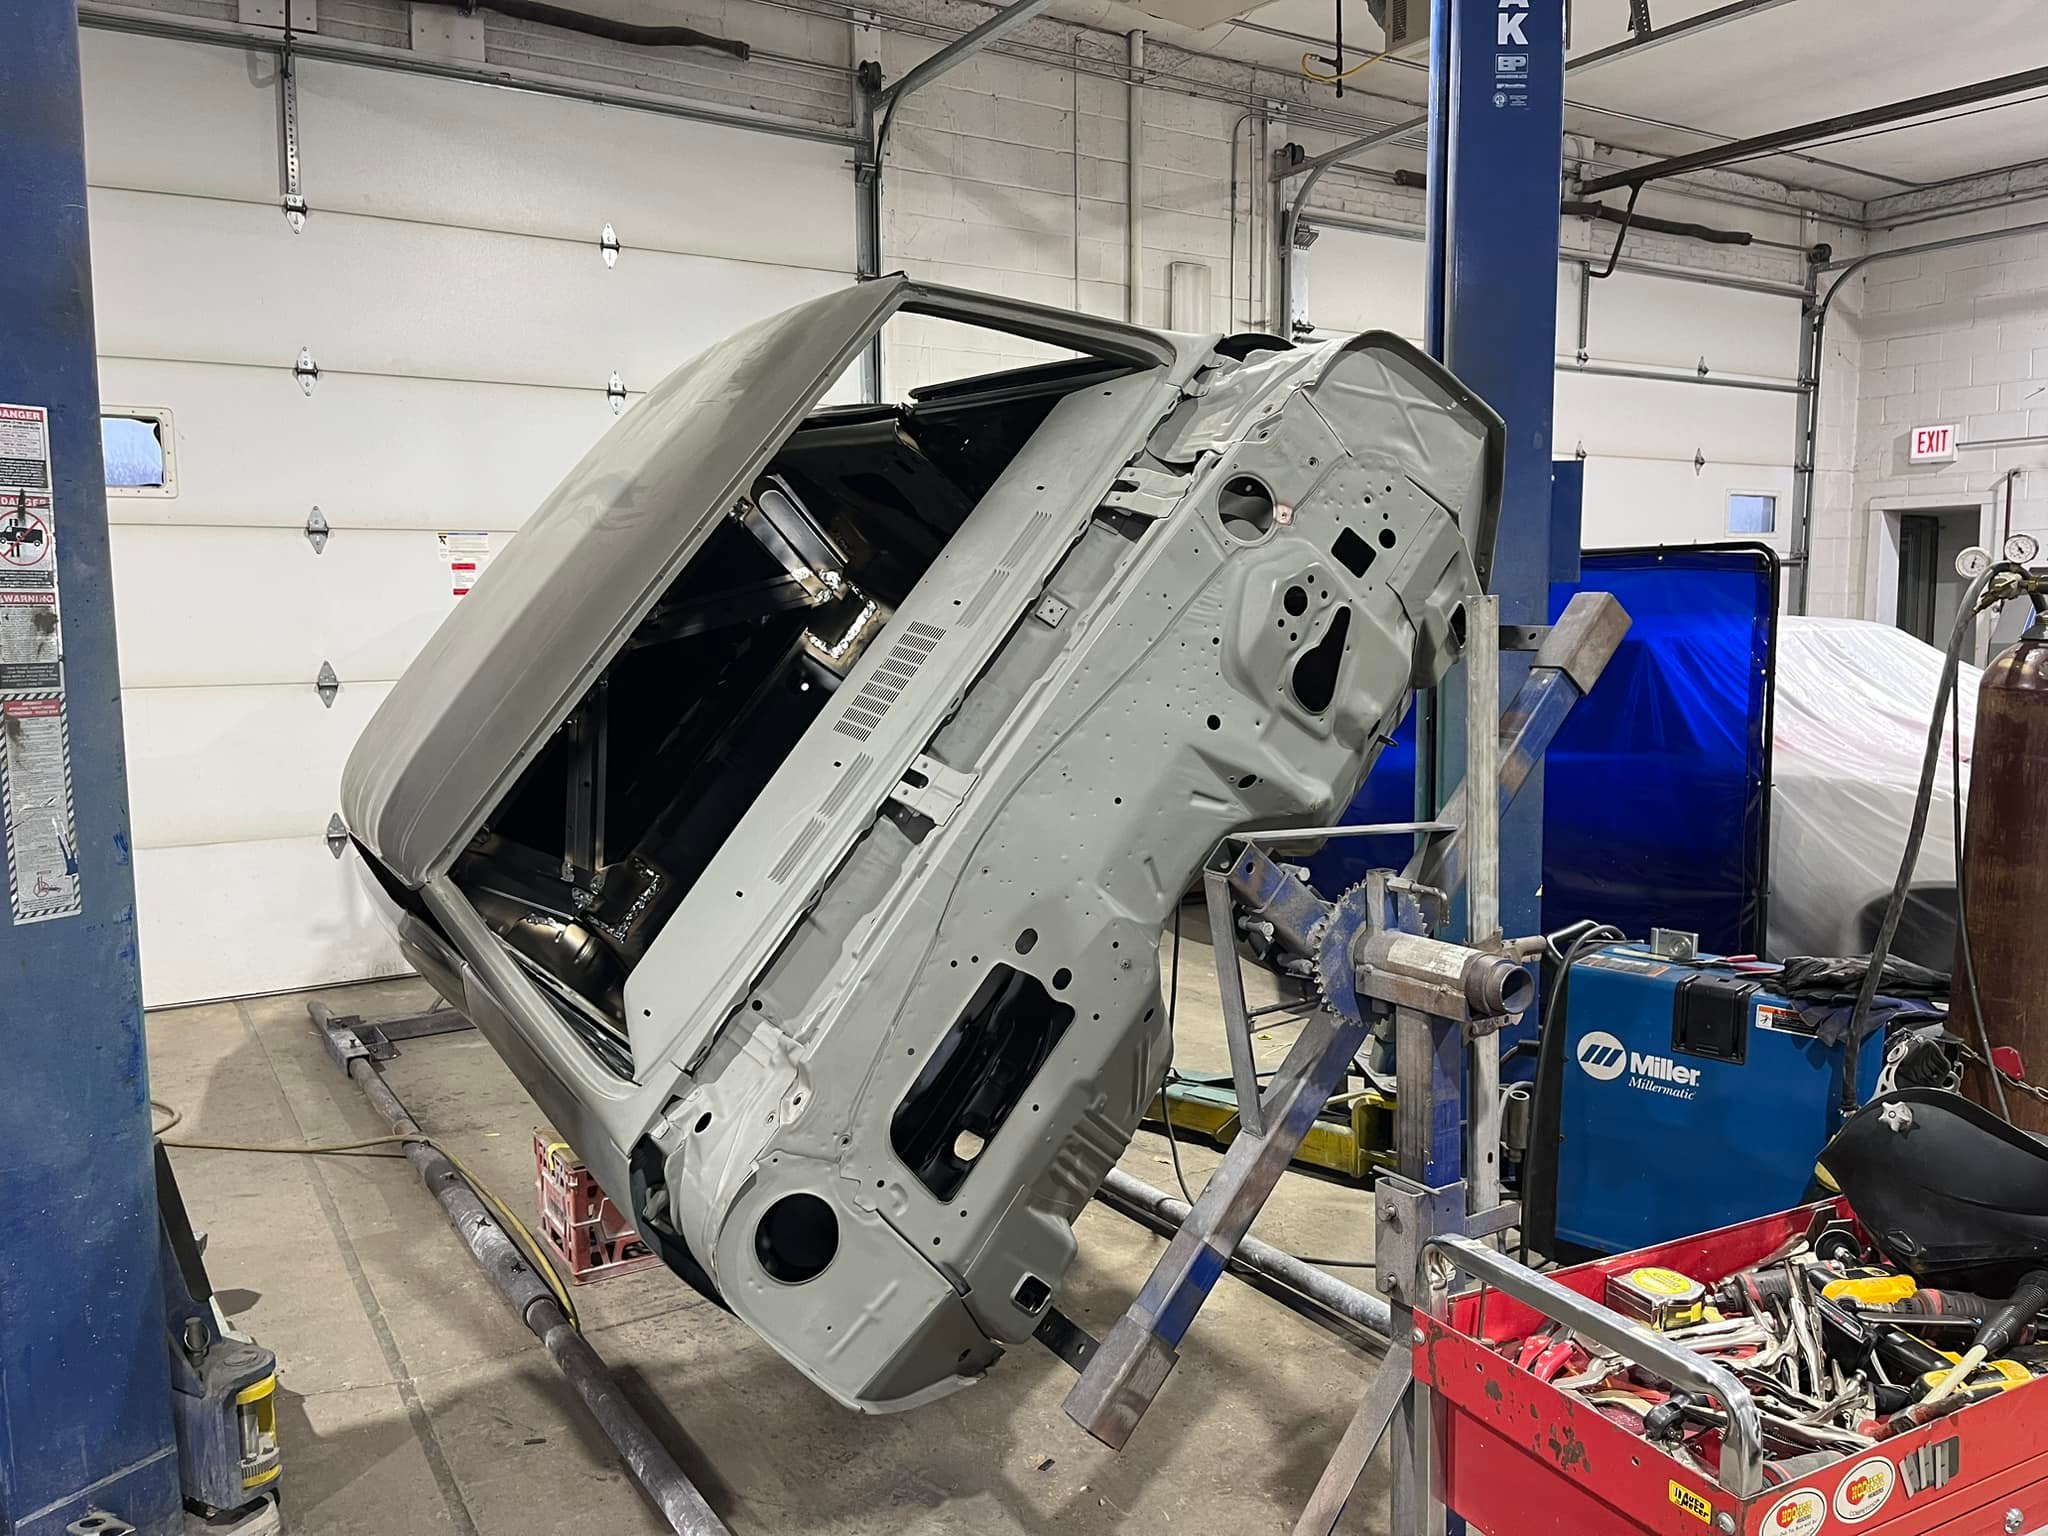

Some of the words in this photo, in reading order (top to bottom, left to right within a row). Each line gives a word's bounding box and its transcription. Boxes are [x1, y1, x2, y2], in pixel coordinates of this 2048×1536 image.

[1497, 0, 1530, 45] K
[1917, 429, 1949, 454] EXIT
[2, 496, 48, 507] DAGER
[4, 594, 54, 603] WARNING
[1630, 1051, 1701, 1087] Miller
[1628, 1076, 1696, 1101] Millermatic
[1680, 1499, 1709, 1518] Meter
[1683, 1492, 1705, 1509] Auto
